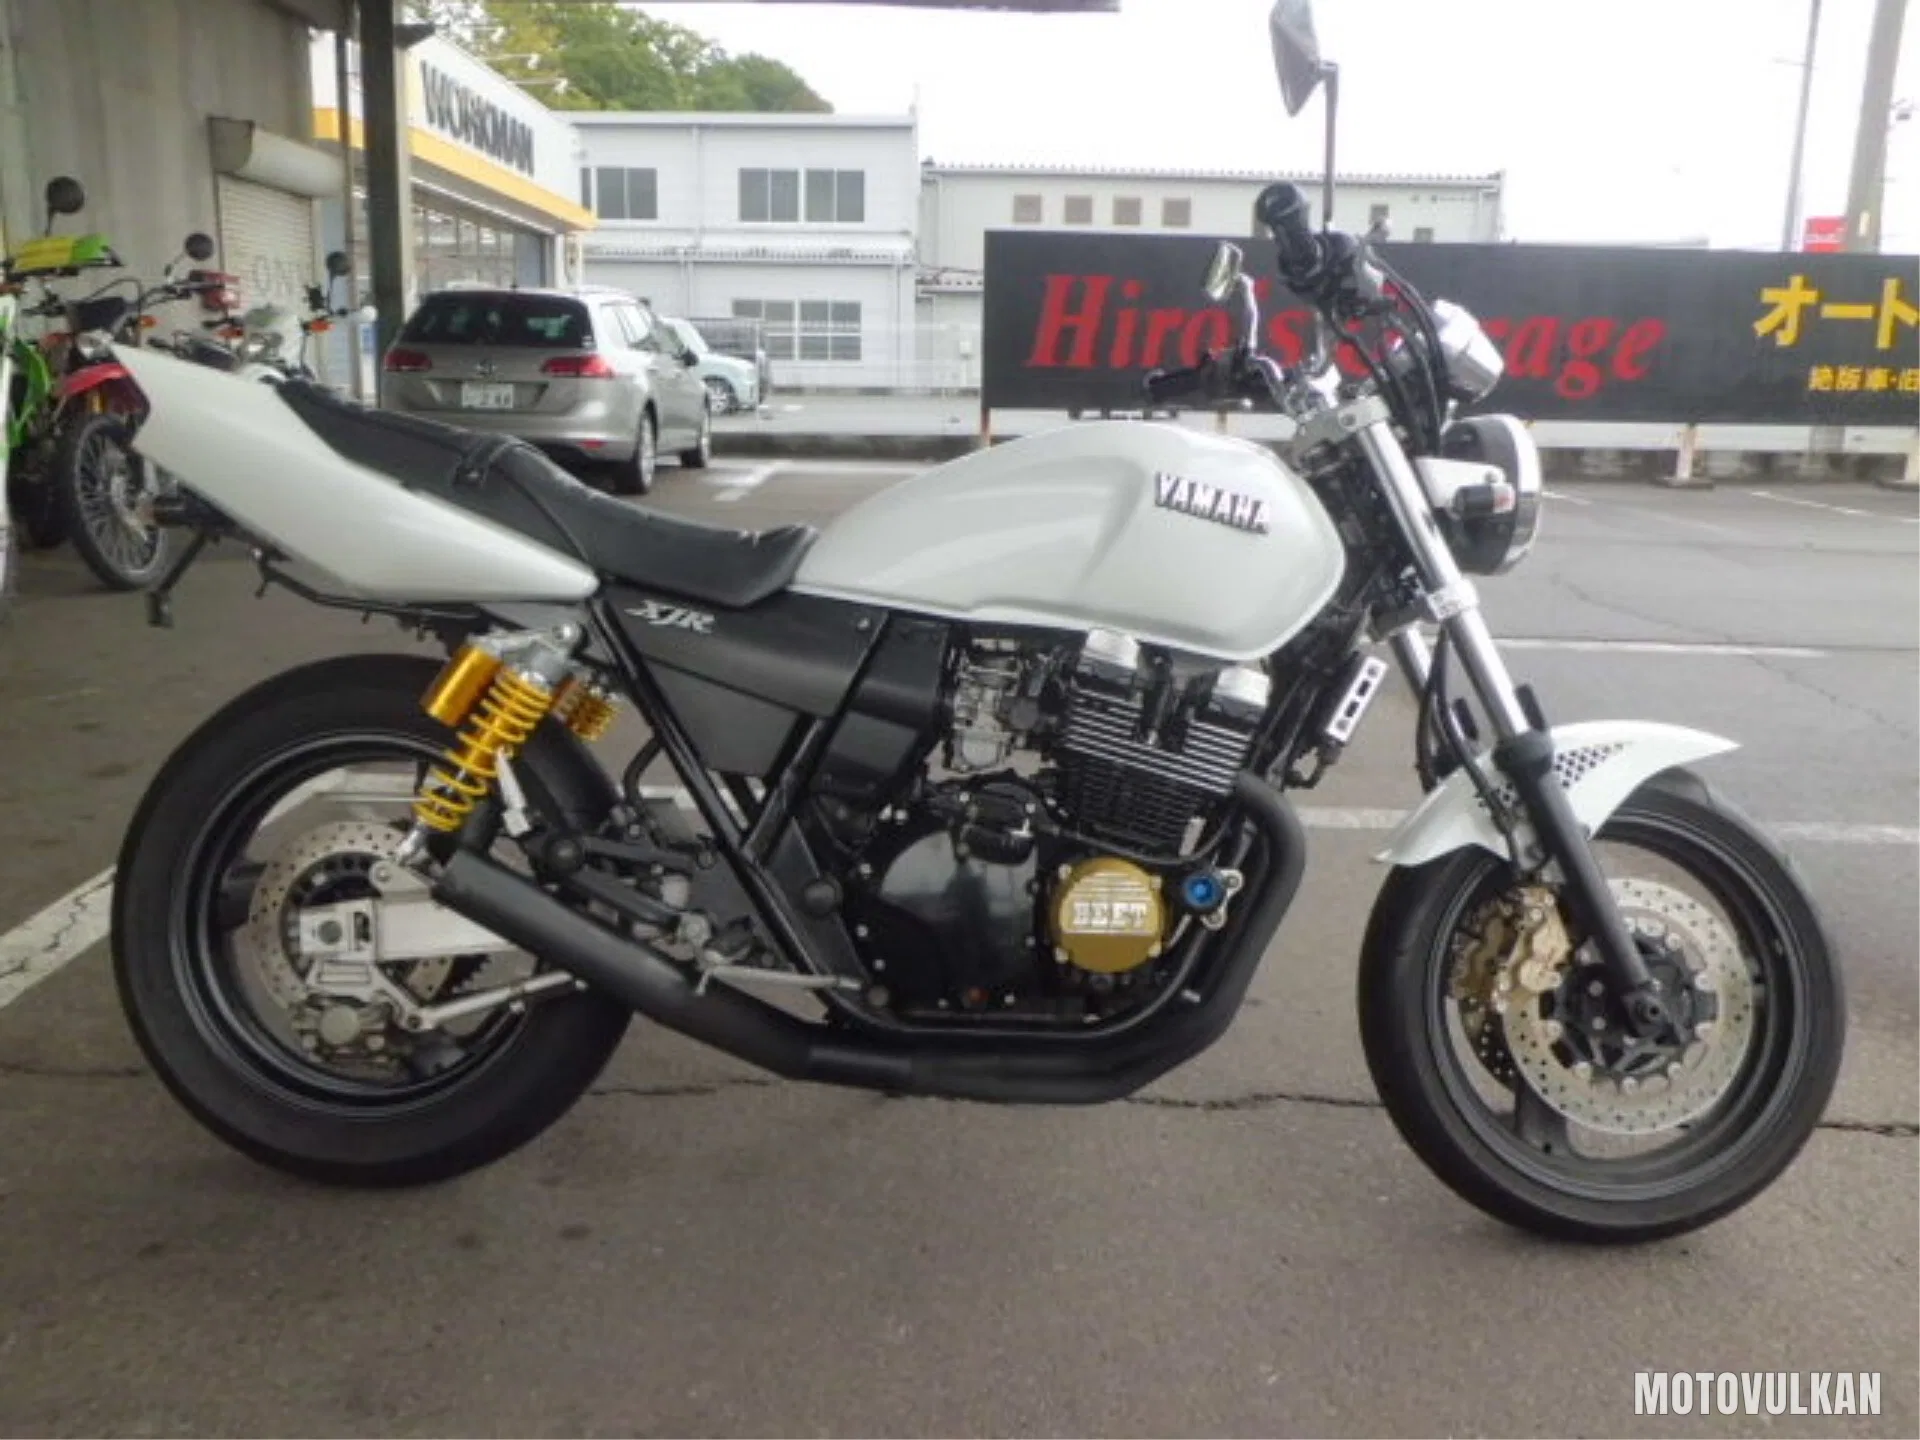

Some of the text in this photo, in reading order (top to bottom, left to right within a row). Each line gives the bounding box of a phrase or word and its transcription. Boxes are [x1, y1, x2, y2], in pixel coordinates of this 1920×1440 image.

[420, 59, 535, 178] WORKMAN
[1023, 272, 1667, 399] Hiro's Gage
[1154, 471, 1270, 535] YAMAHA
[623, 599, 715, 634] XJR
